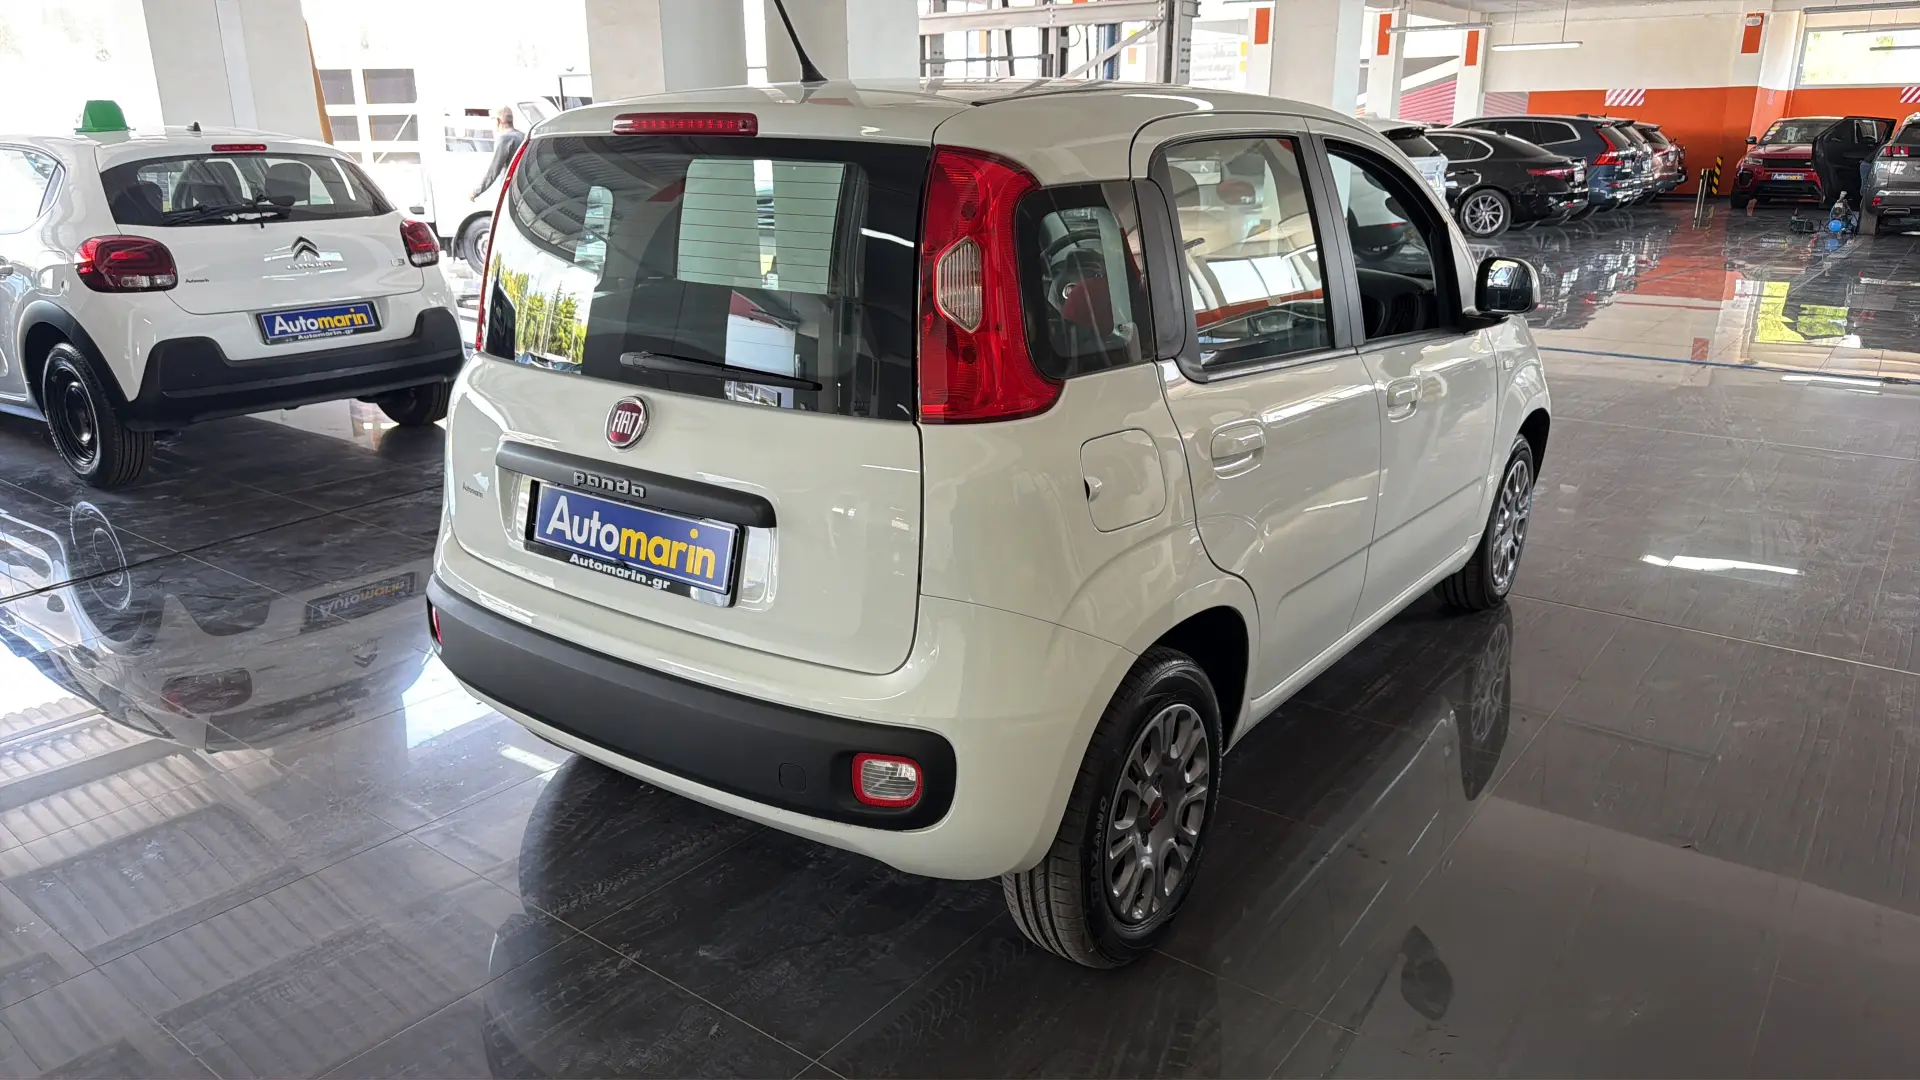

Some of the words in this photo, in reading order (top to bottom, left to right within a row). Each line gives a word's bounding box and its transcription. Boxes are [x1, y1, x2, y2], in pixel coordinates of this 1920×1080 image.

[274, 308, 369, 335] Automarin
[298, 329, 354, 340] Automarin.gr
[611, 409, 639, 435] FIAT
[573, 471, 647, 498] panda
[546, 495, 716, 579] Automarin
[569, 553, 671, 590] Automarin.gr
